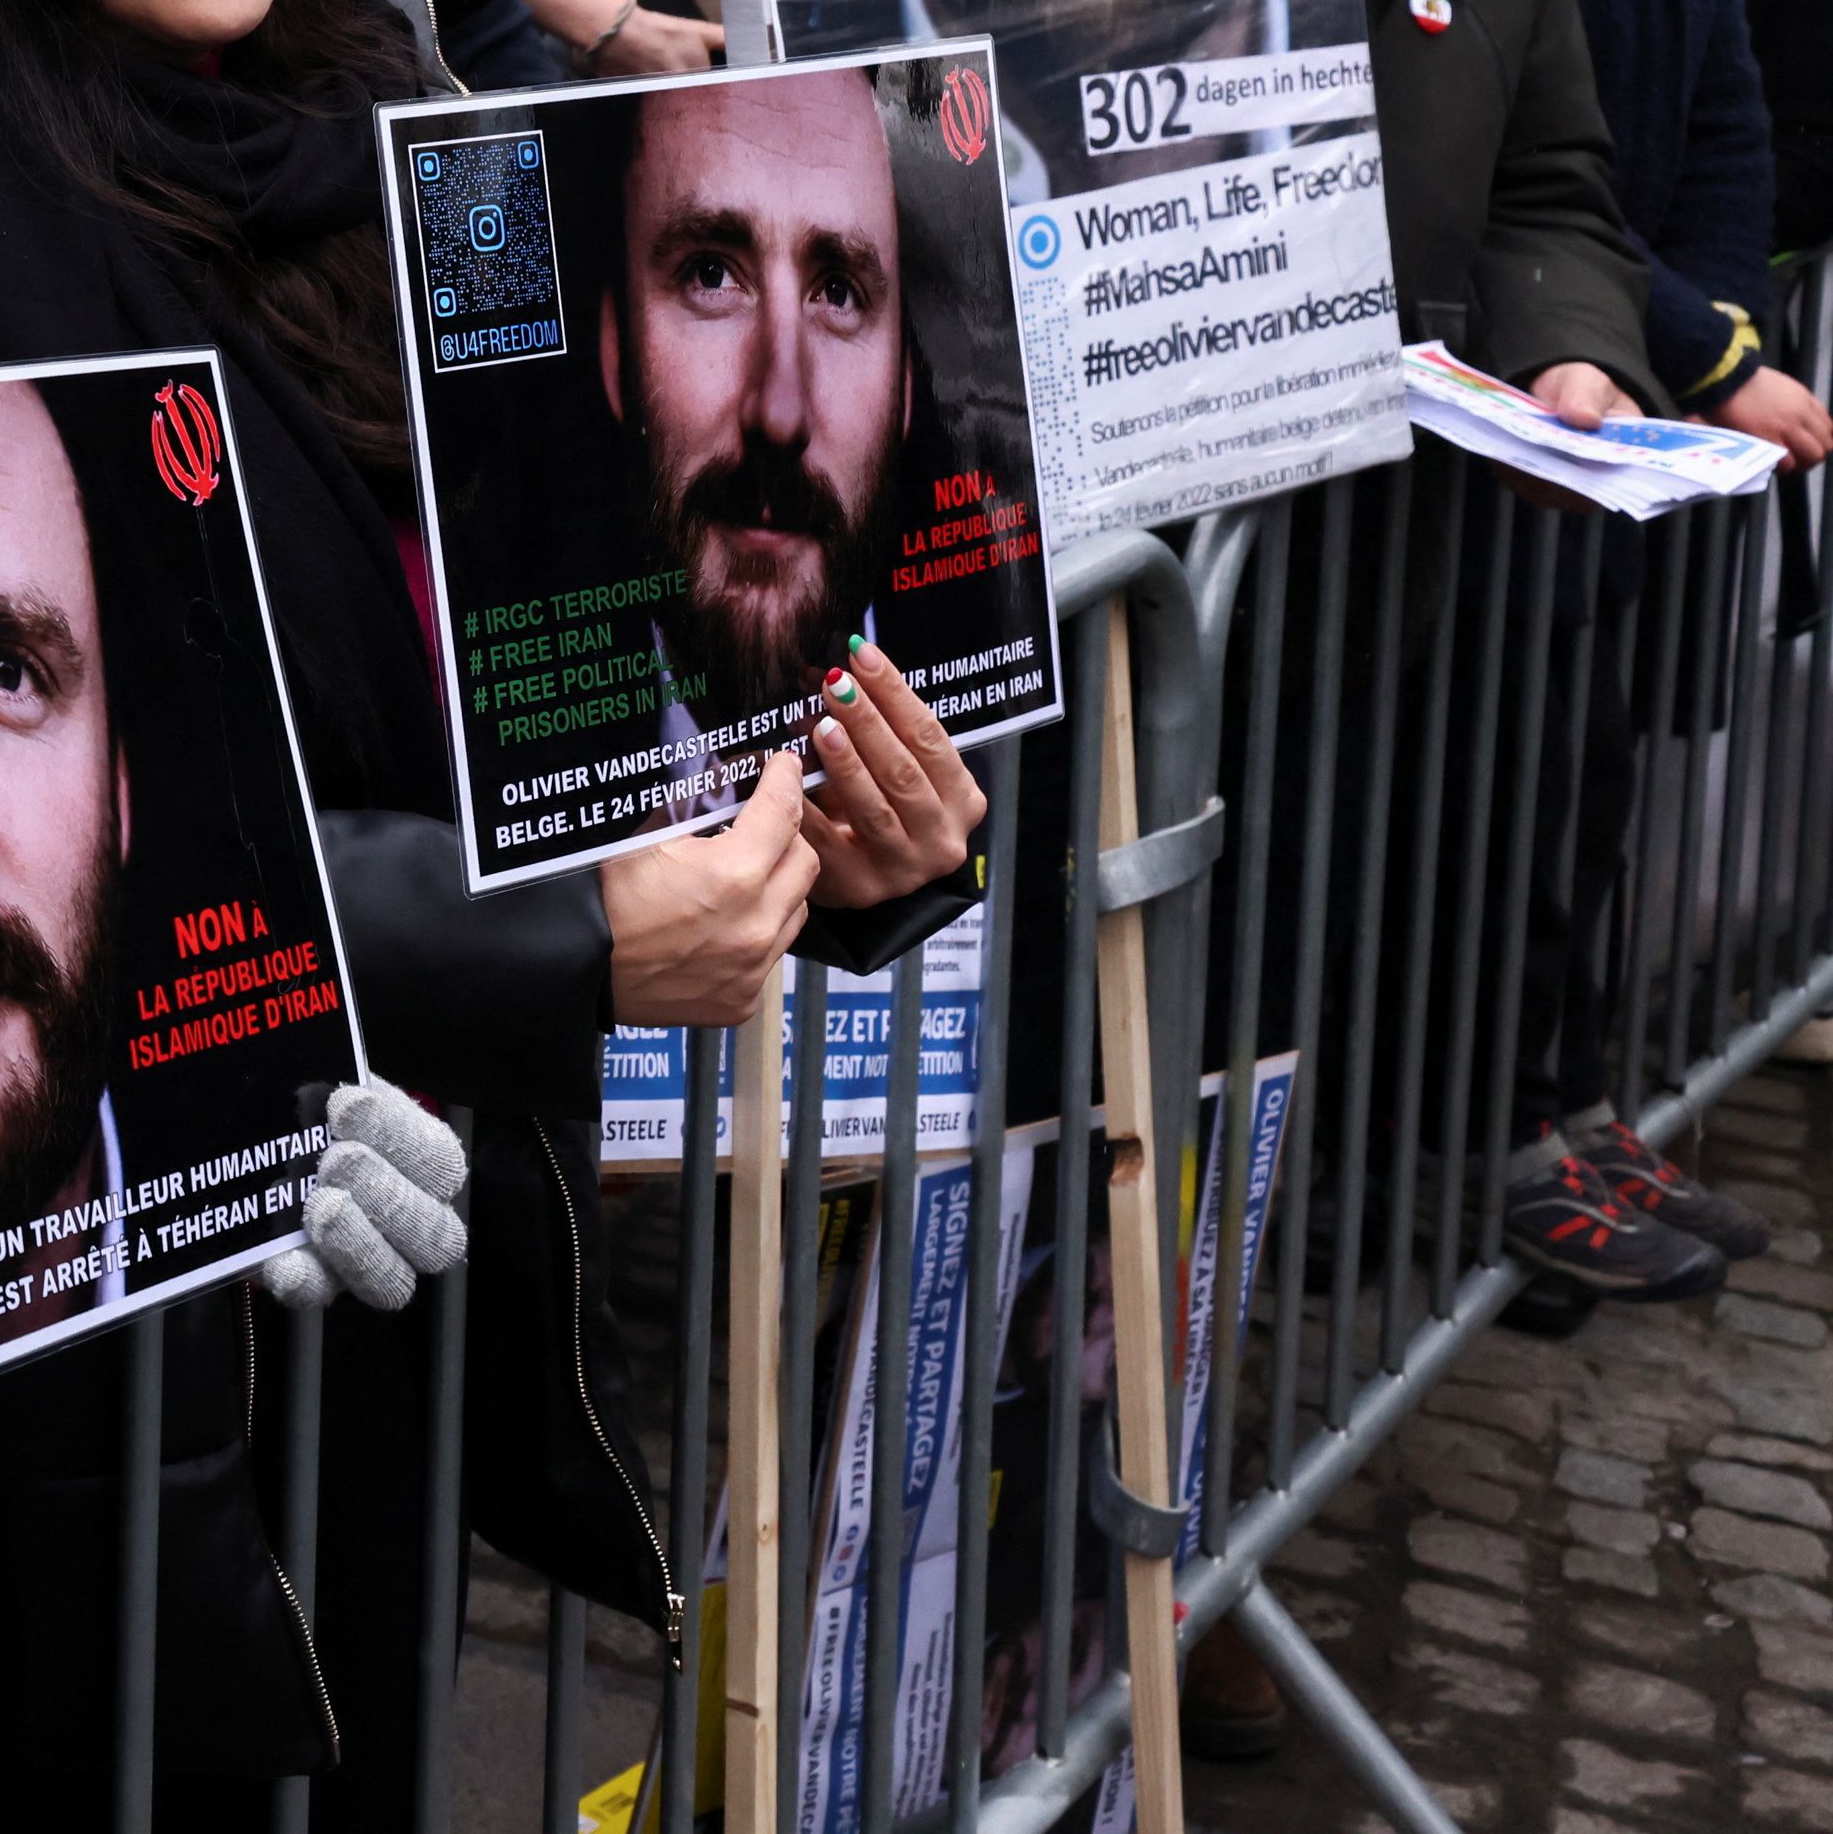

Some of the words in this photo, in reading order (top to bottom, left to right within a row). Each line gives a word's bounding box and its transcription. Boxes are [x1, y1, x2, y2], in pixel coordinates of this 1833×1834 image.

[1085, 67, 1192, 150] 302
[1196, 75, 1267, 106] dagen
[1273, 68, 1295, 93] in
[1074, 193, 1200, 251] Woman,
[1205, 175, 1269, 221] Life,
[1083, 230, 1289, 317] #MahsaAmini
[437, 319, 560, 364] @U4FREEDOM
[934, 470, 981, 512] NON
[893, 548, 987, 592] ISLAMIQUE
[989, 532, 1039, 568] D'IRAN
[903, 532, 926, 556] LA
[484, 598, 544, 635] IRGC
[549, 568, 688, 622] TERRORISTE
[489, 635, 553, 673] FREE
[558, 622, 613, 657] IRAN
[494, 672, 555, 709] FREE
[562, 647, 674, 695] POLITICAL
[498, 693, 631, 747] PRISONERS
[501, 767, 591, 807] OLIVIER
[594, 719, 748, 784] VANDECASTEELE
[751, 708, 779, 738] EST
[782, 700, 804, 724] UN
[932, 636, 1035, 684] HUMANITAIRE
[495, 811, 575, 849] BELGE.
[580, 801, 607, 828] LE
[611, 793, 635, 820] 24
[639, 778, 716, 812] FÉVRIER
[719, 755, 761, 785] 2022,
[927, 686, 981, 720] HÉRAN
[985, 684, 1006, 706] EN
[1009, 668, 1043, 697] IRAN
[173, 900, 246, 960] NON
[137, 985, 171, 1021] LA
[175, 941, 319, 1011] RÉPUBLIQUE
[128, 1004, 258, 1070] ISLAMIQUE
[264, 980, 339, 1032] D'IRAN
[852, 1009, 886, 1043] ET
[603, 1048, 670, 1079] ÉTITION
[29, 1171, 185, 1250] TRAVAILLEUR
[42, 1233, 132, 1299] ARRÊTÉ
[157, 1194, 260, 1253] TÉHÉRAN
[264, 1187, 295, 1215] EN
[936, 1181, 970, 1294] SIGNEZ
